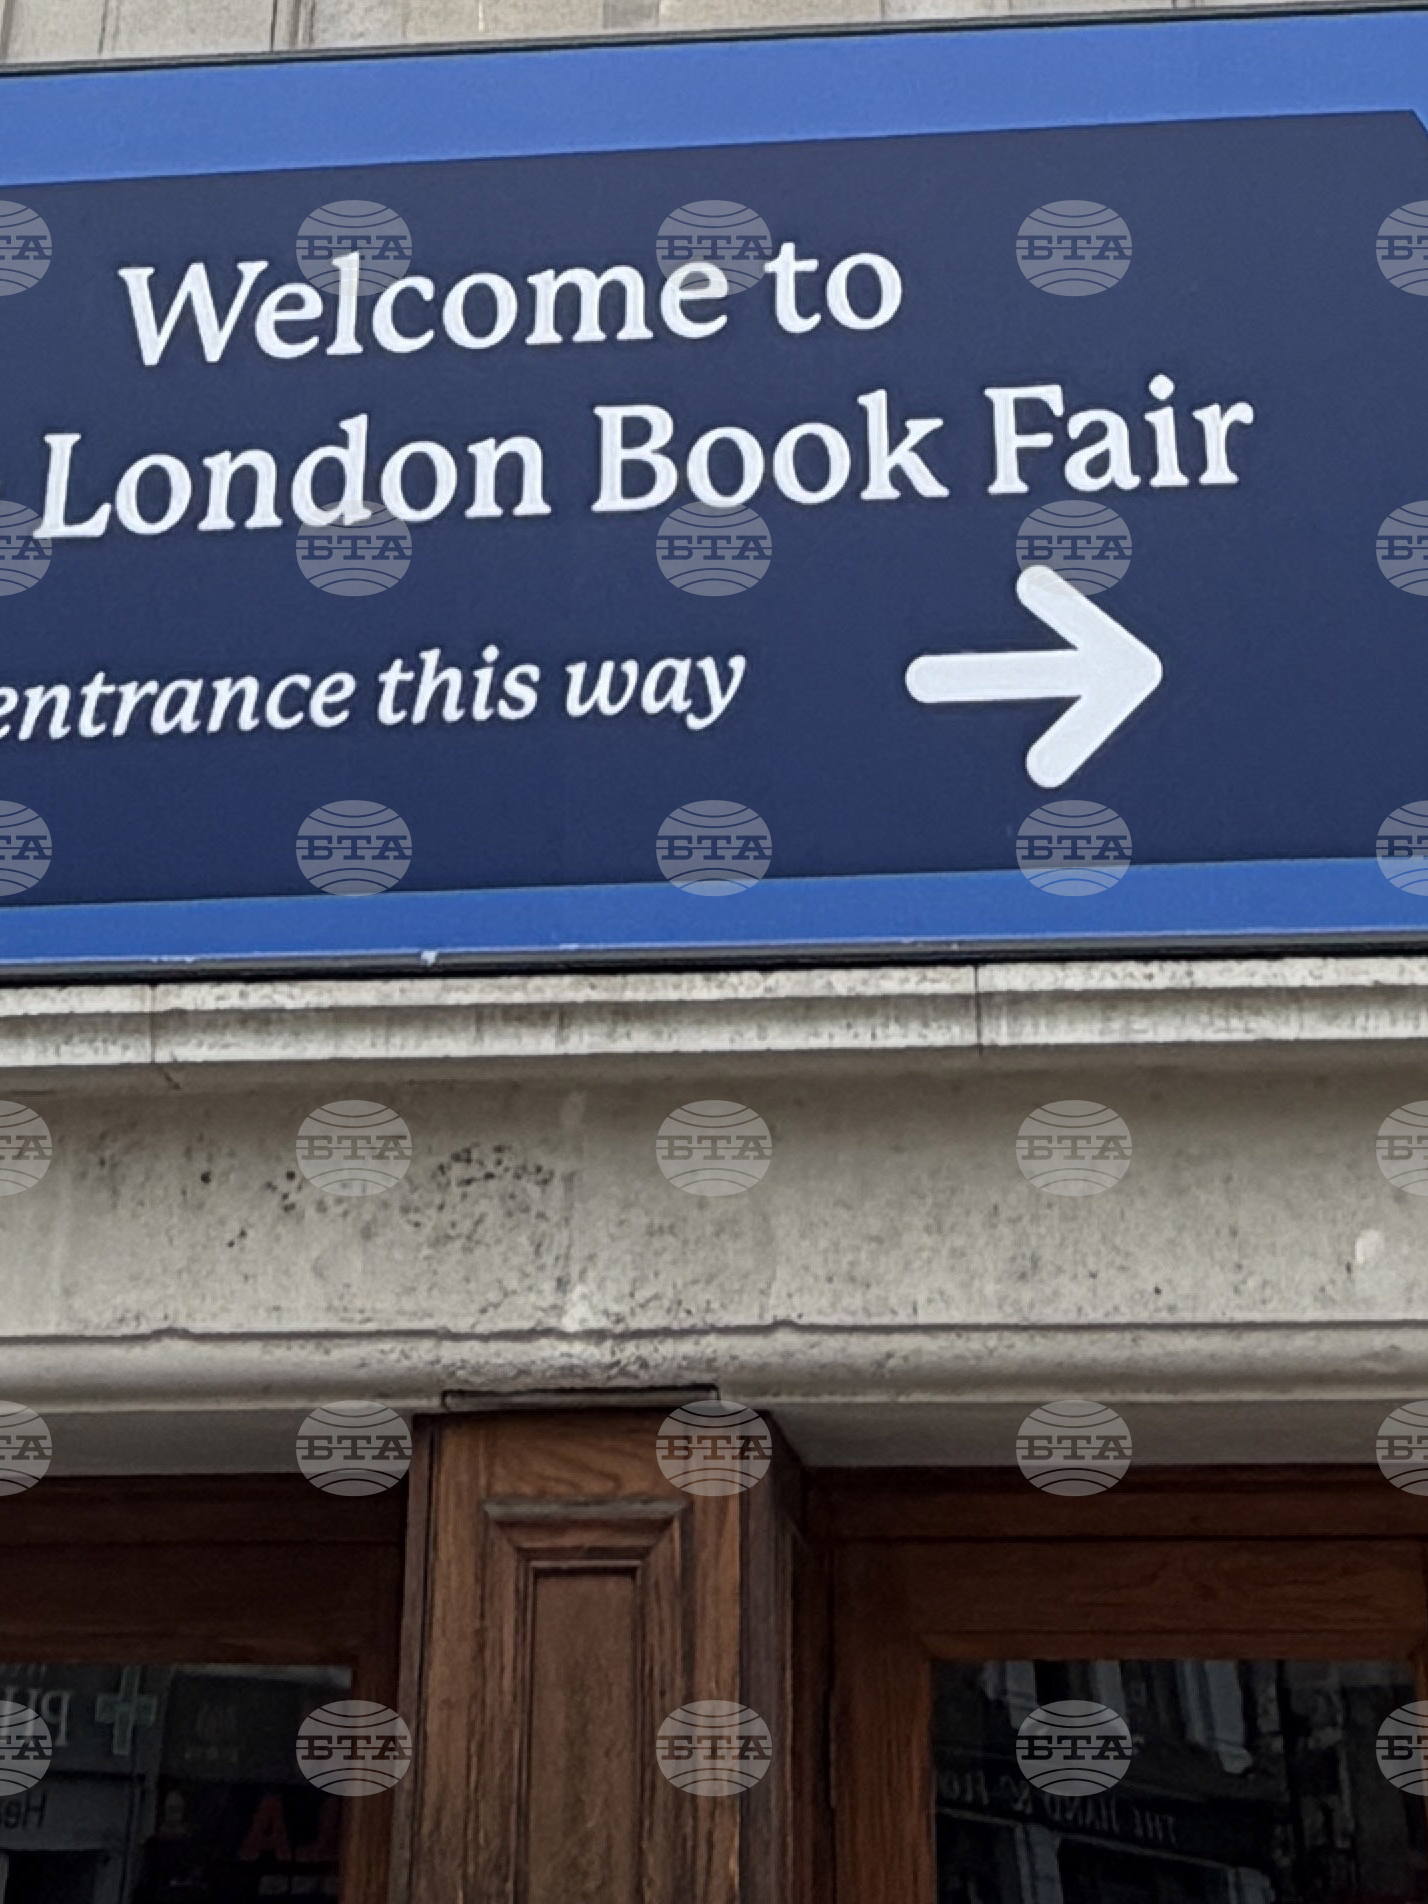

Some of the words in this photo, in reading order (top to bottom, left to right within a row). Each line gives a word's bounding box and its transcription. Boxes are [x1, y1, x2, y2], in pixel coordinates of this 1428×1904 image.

[117, 250, 729, 367] Welcome
[763, 241, 903, 335] to
[31, 413, 553, 539] London
[591, 388, 950, 513] Book
[983, 373, 1255, 495] Fair
[377, 645, 541, 725] this
[565, 655, 747, 732] way
